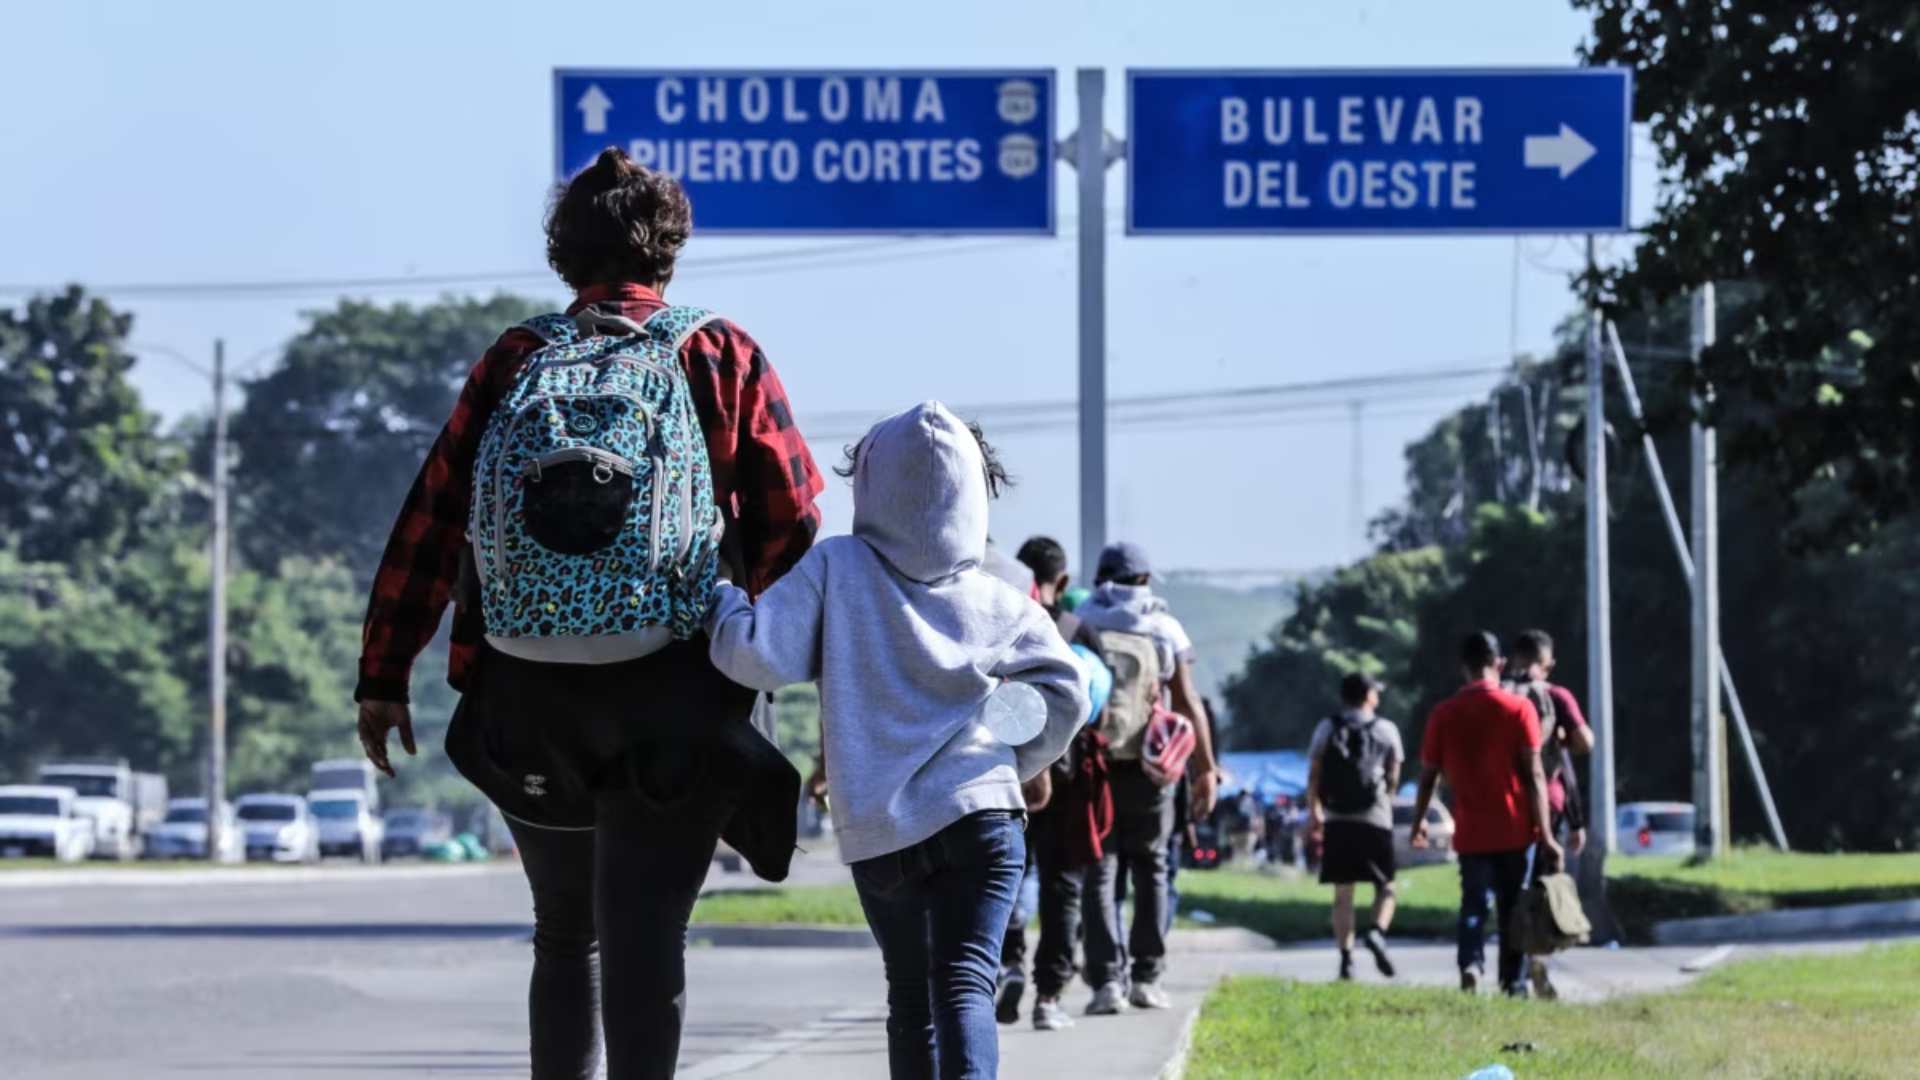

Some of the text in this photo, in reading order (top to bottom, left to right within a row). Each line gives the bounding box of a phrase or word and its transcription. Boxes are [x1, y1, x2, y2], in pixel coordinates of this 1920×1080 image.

[656, 78, 945, 122] CHOLOMA
[1222, 97, 1482, 144] BULEVAR
[629, 139, 799, 181] PUERTO
[814, 139, 982, 181] CORTES
[1224, 161, 1475, 207] DEL OESTE
